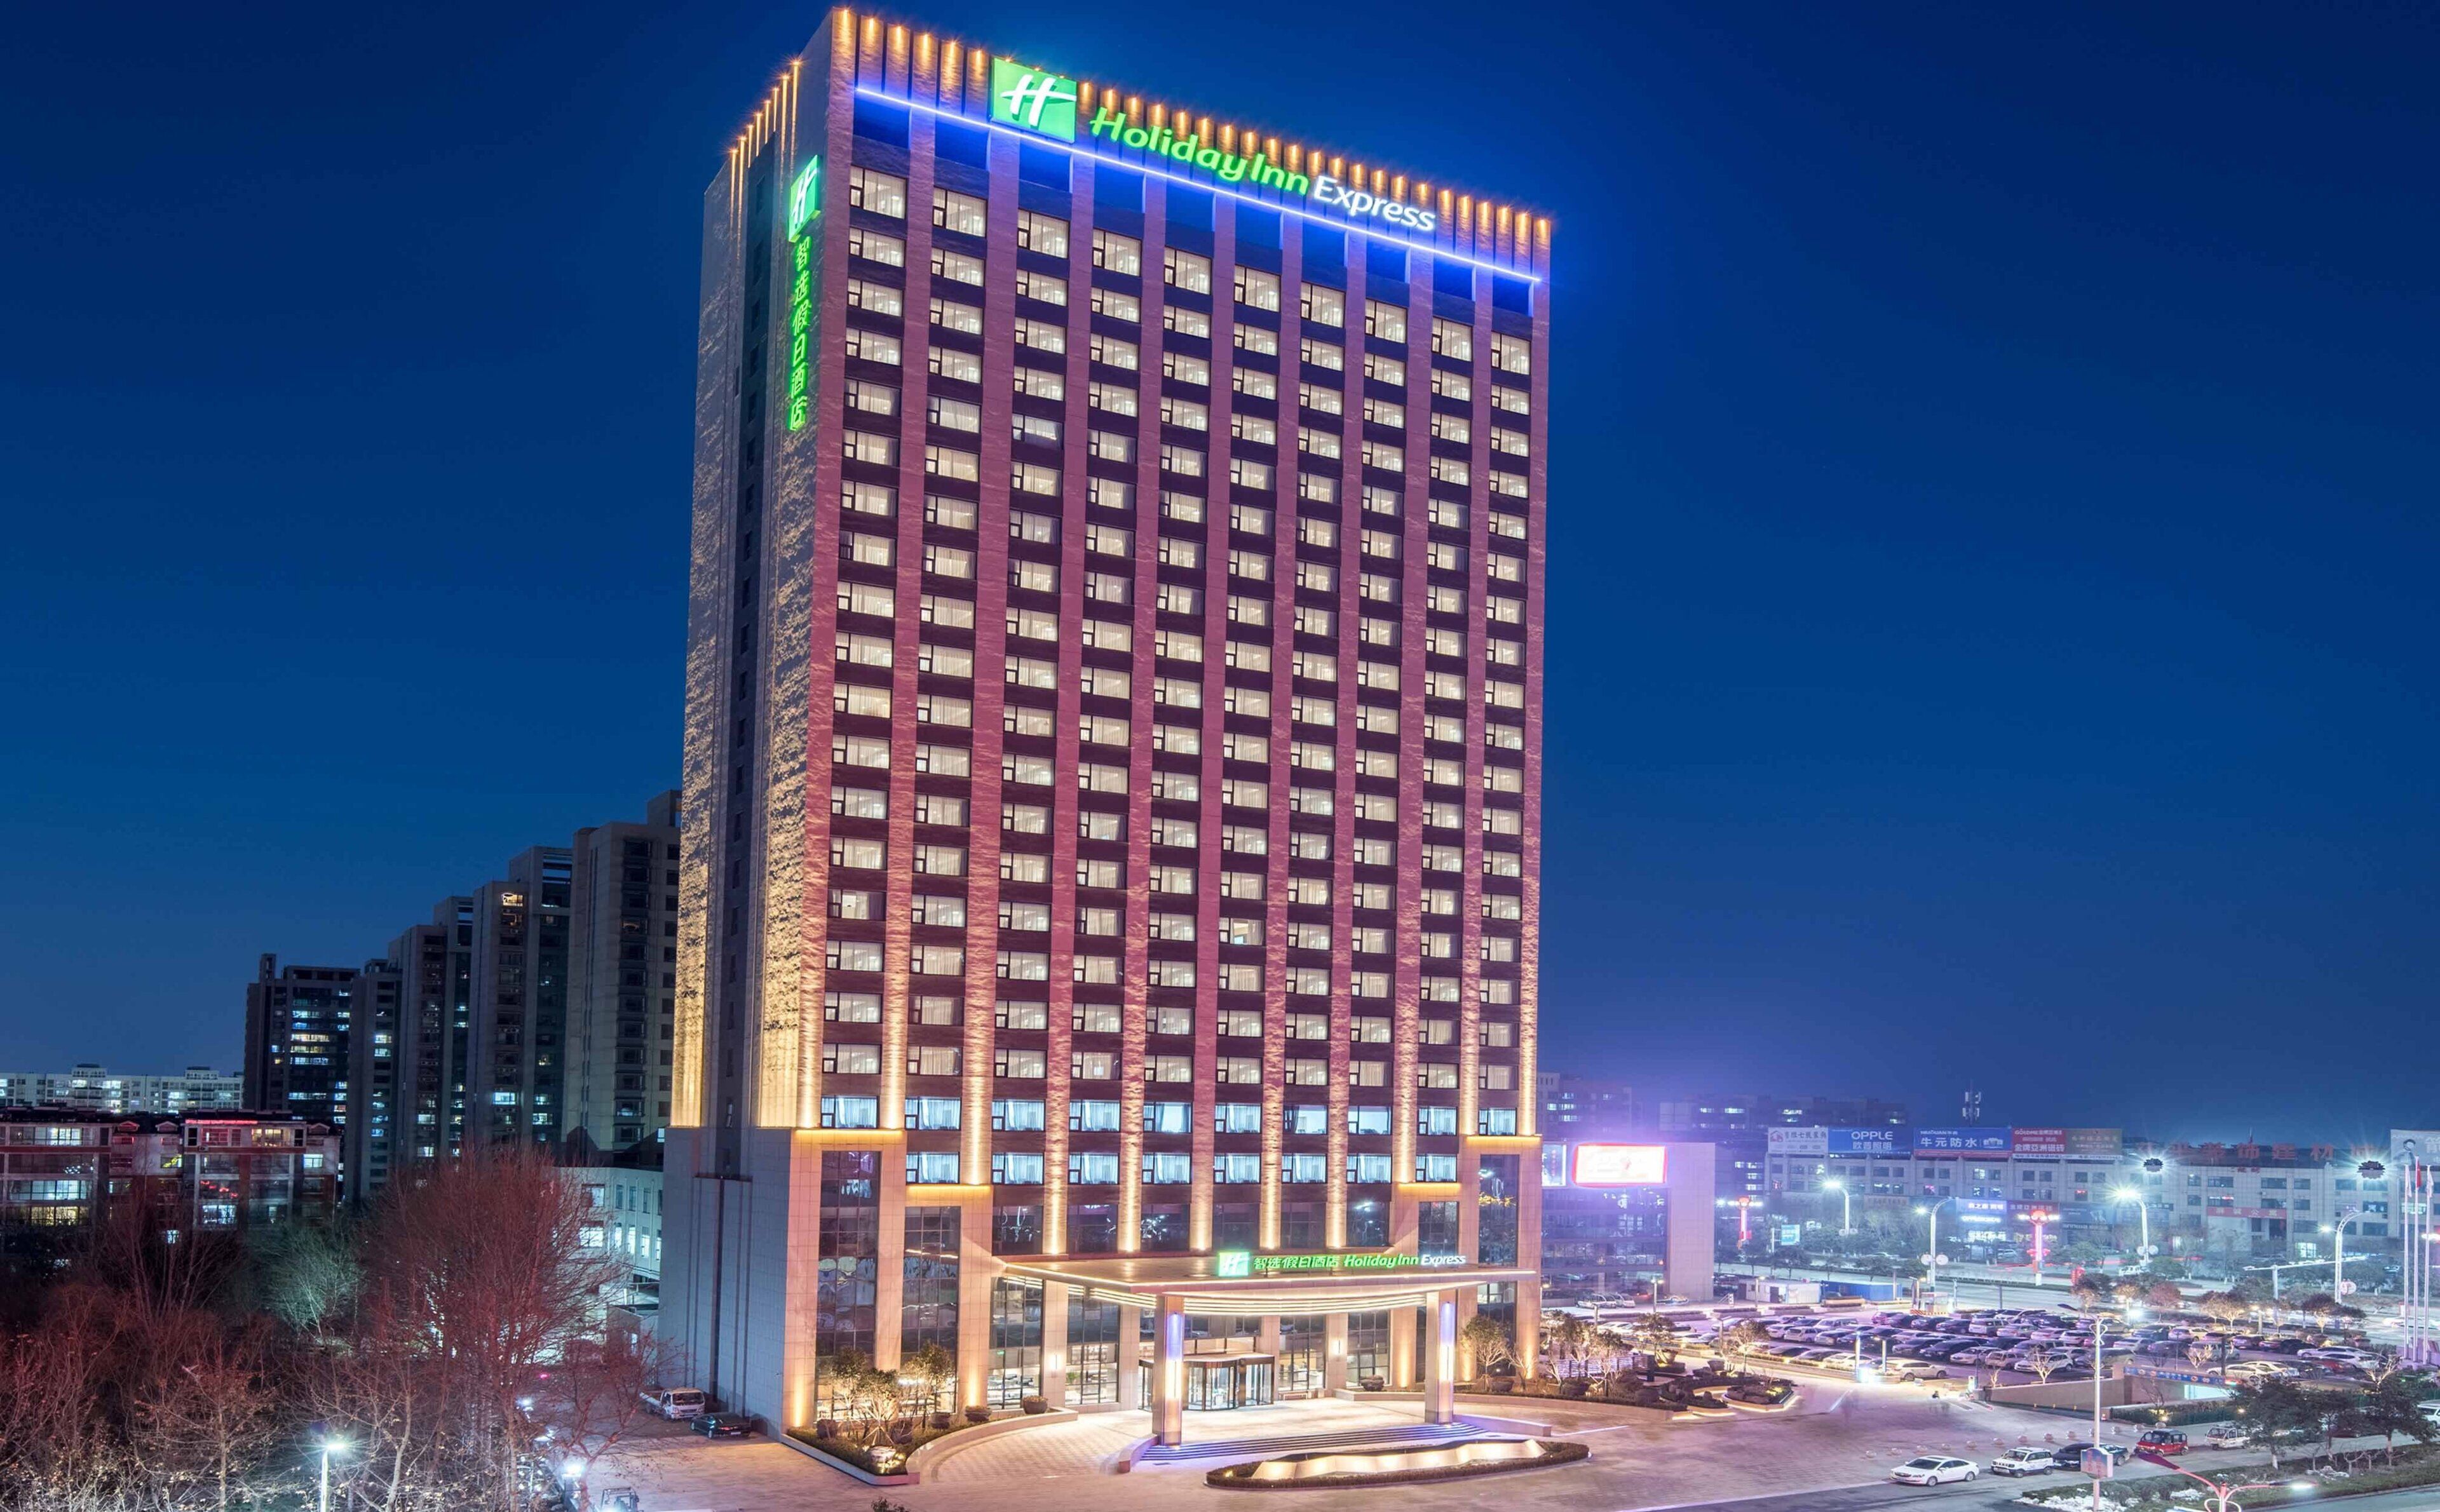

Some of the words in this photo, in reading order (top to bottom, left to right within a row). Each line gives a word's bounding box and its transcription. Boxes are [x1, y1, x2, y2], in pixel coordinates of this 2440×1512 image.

[1090, 107, 1249, 182] Holiday
[1251, 152, 1310, 195] Inn
[1313, 175, 1436, 232] Express
[789, 238, 811, 431] 智选假日酒店
[1851, 1131, 1894, 1140] OPPLE
[1920, 1137, 1977, 1147] 牛元防水
[1853, 1142, 1892, 1150] 欧普照明
[1254, 1255, 1339, 1270] 智选假日酒店
[1343, 1254, 1396, 1269] Holiday
[1398, 1253, 1419, 1266] Inn
[1420, 1253, 1467, 1267] Express
